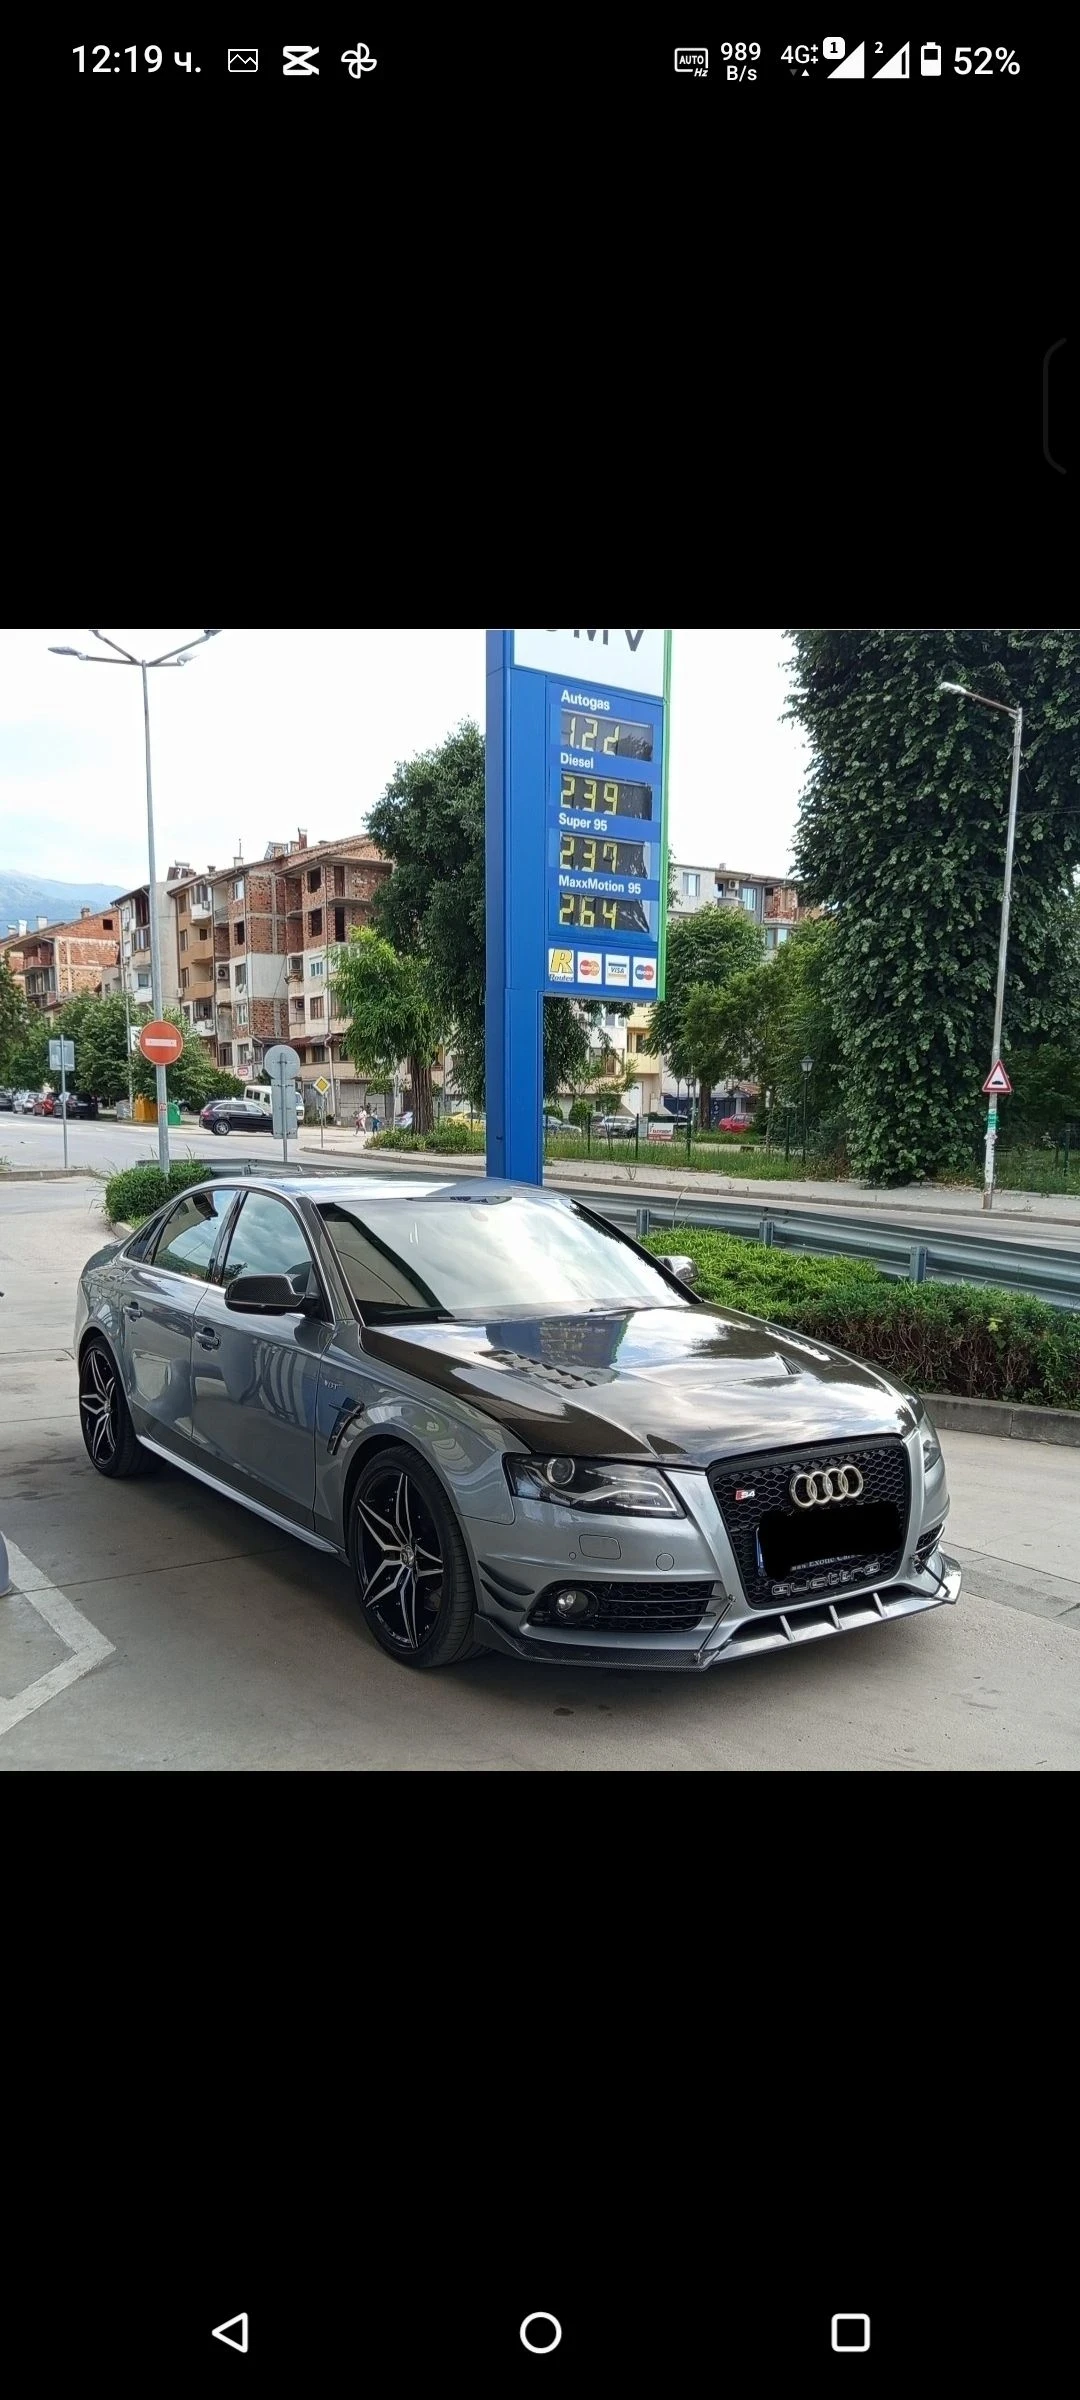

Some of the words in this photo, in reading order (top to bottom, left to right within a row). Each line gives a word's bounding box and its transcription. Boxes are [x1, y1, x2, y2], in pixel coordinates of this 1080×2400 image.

[561, 689, 611, 711] Autogas
[560, 752, 594, 769] Diesel
[560, 776, 618, 816] 2.39
[558, 813, 591, 830] Super
[593, 817, 608, 832] 95
[559, 836, 618, 875] 2.37
[558, 874, 625, 893] MaxxMotion
[627, 879, 642, 895] 95
[772, 1562, 881, 1597] quattro
